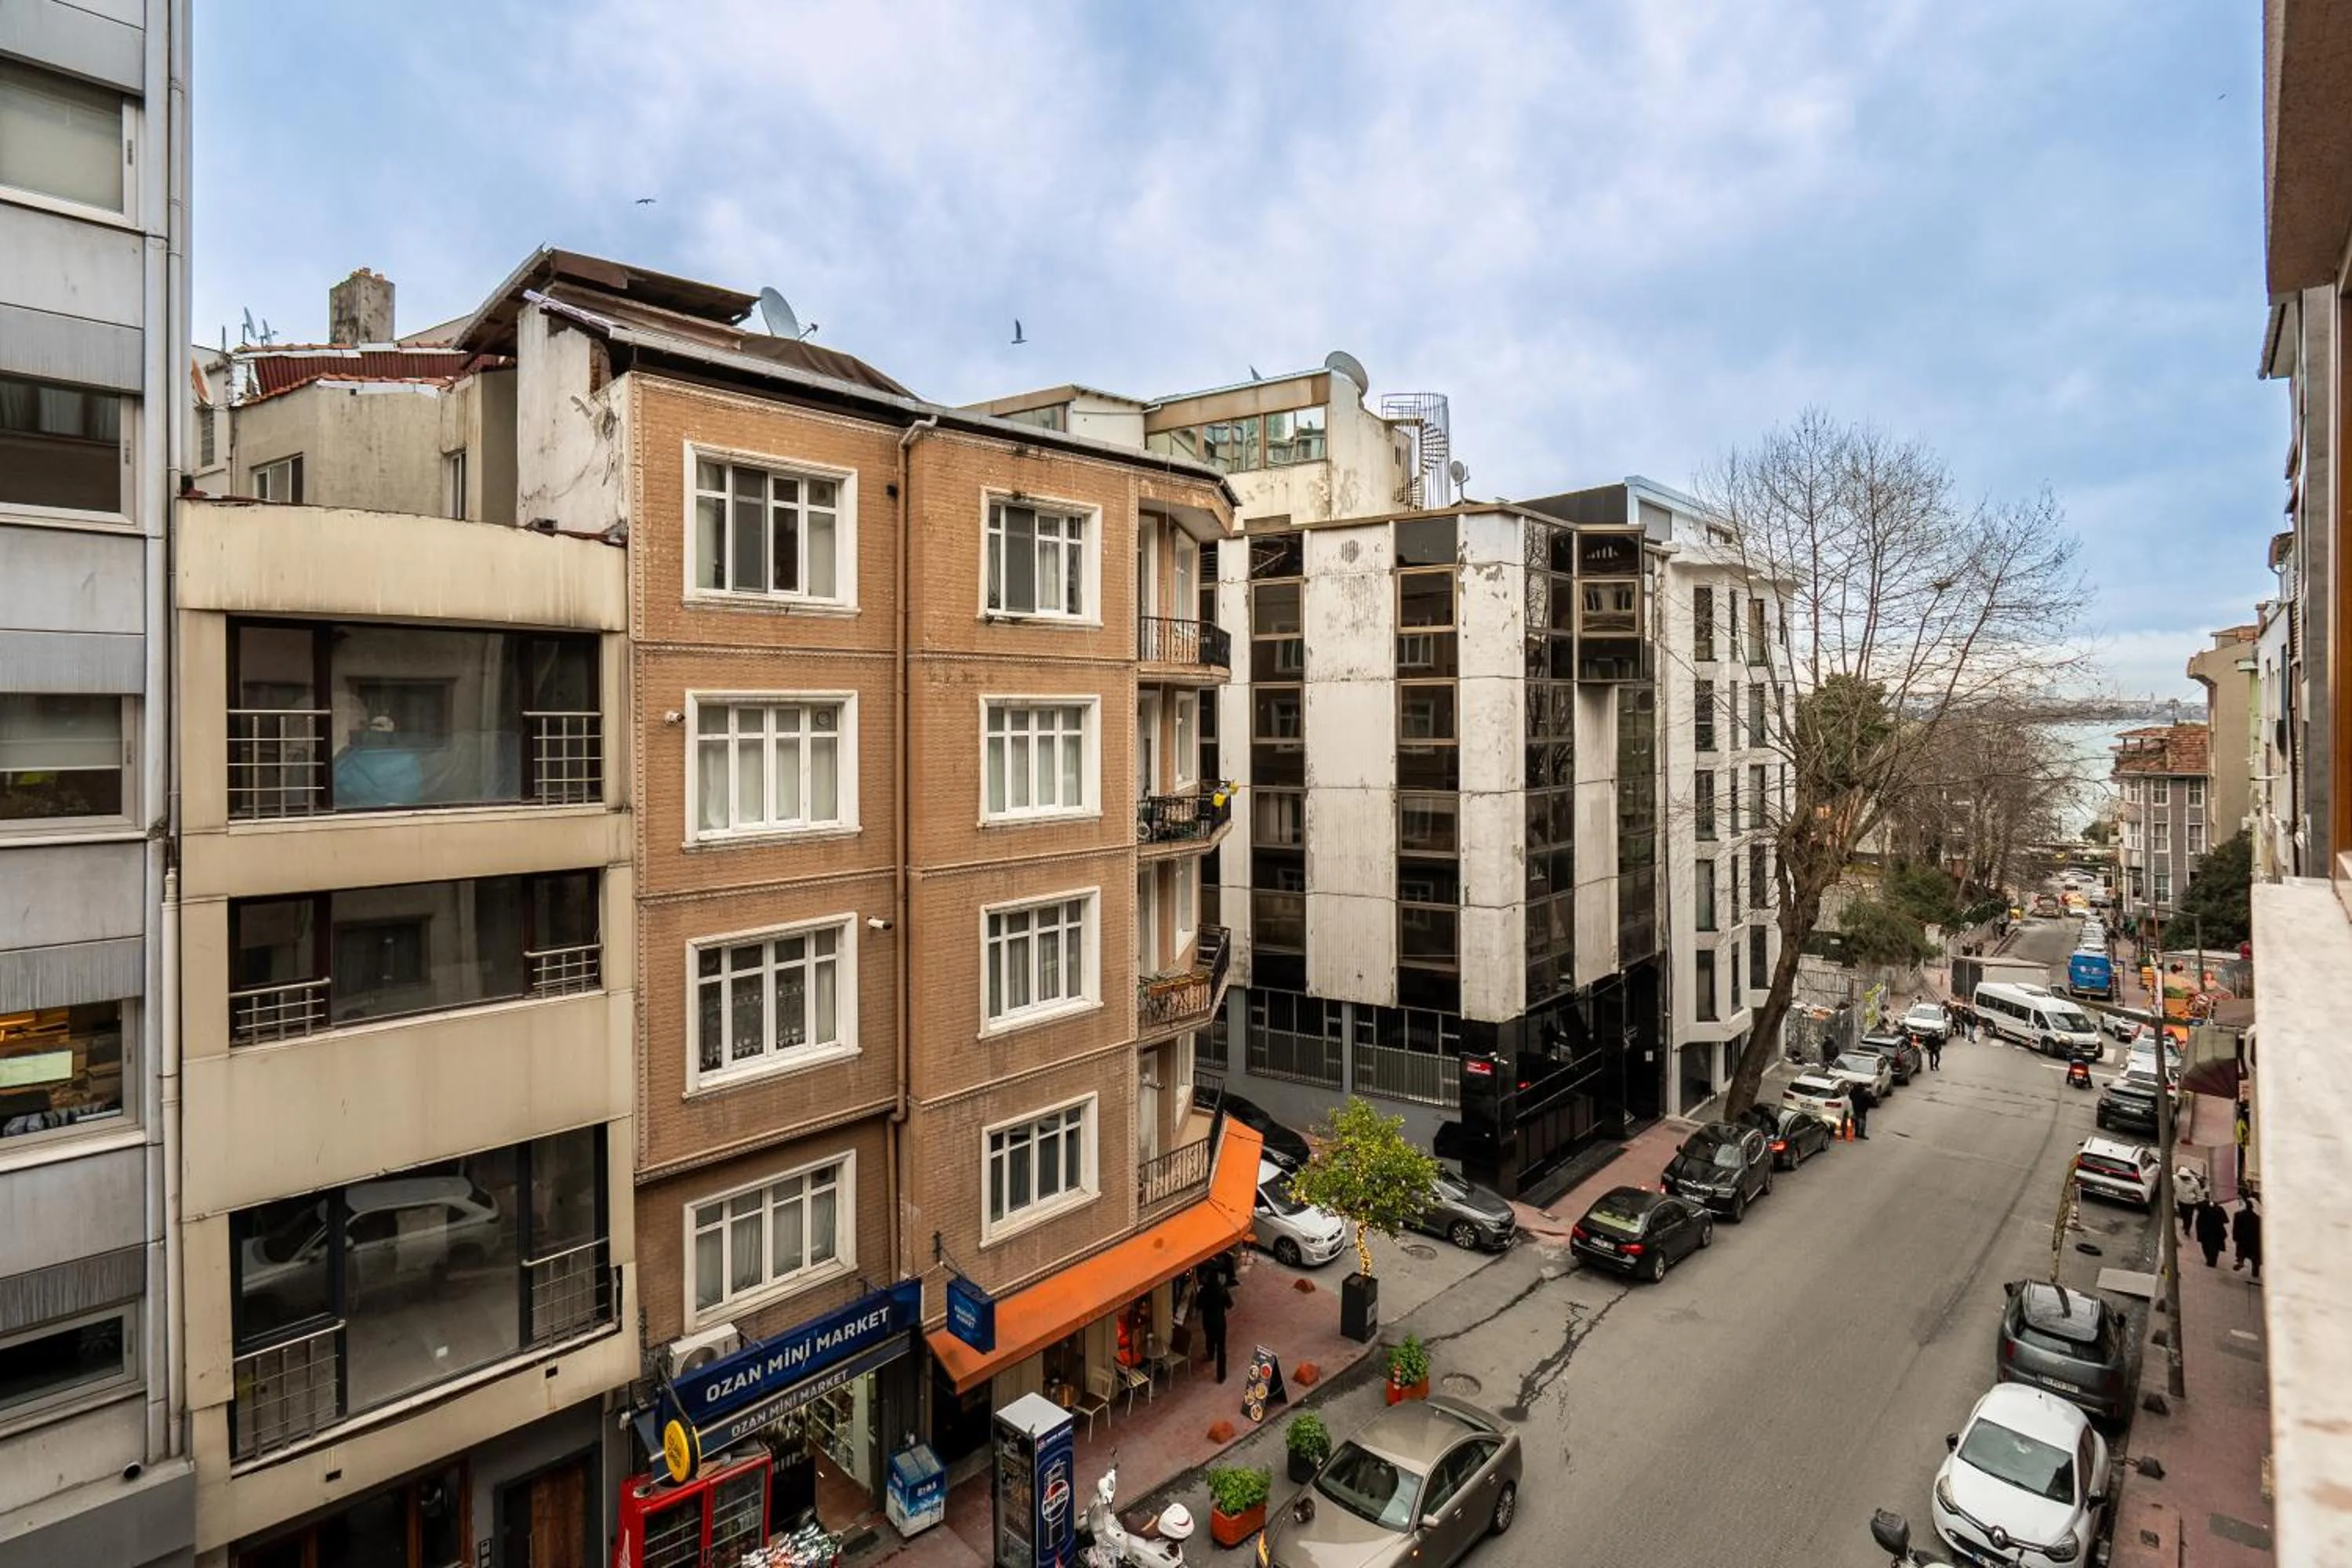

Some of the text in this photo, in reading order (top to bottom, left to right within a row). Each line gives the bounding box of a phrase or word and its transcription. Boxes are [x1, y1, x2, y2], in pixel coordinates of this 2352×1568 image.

[706, 1305, 890, 1403] OZAN MİNİ MARKET
[731, 1411, 766, 1437] OZAN
[800, 1368, 849, 1403] MARKET
